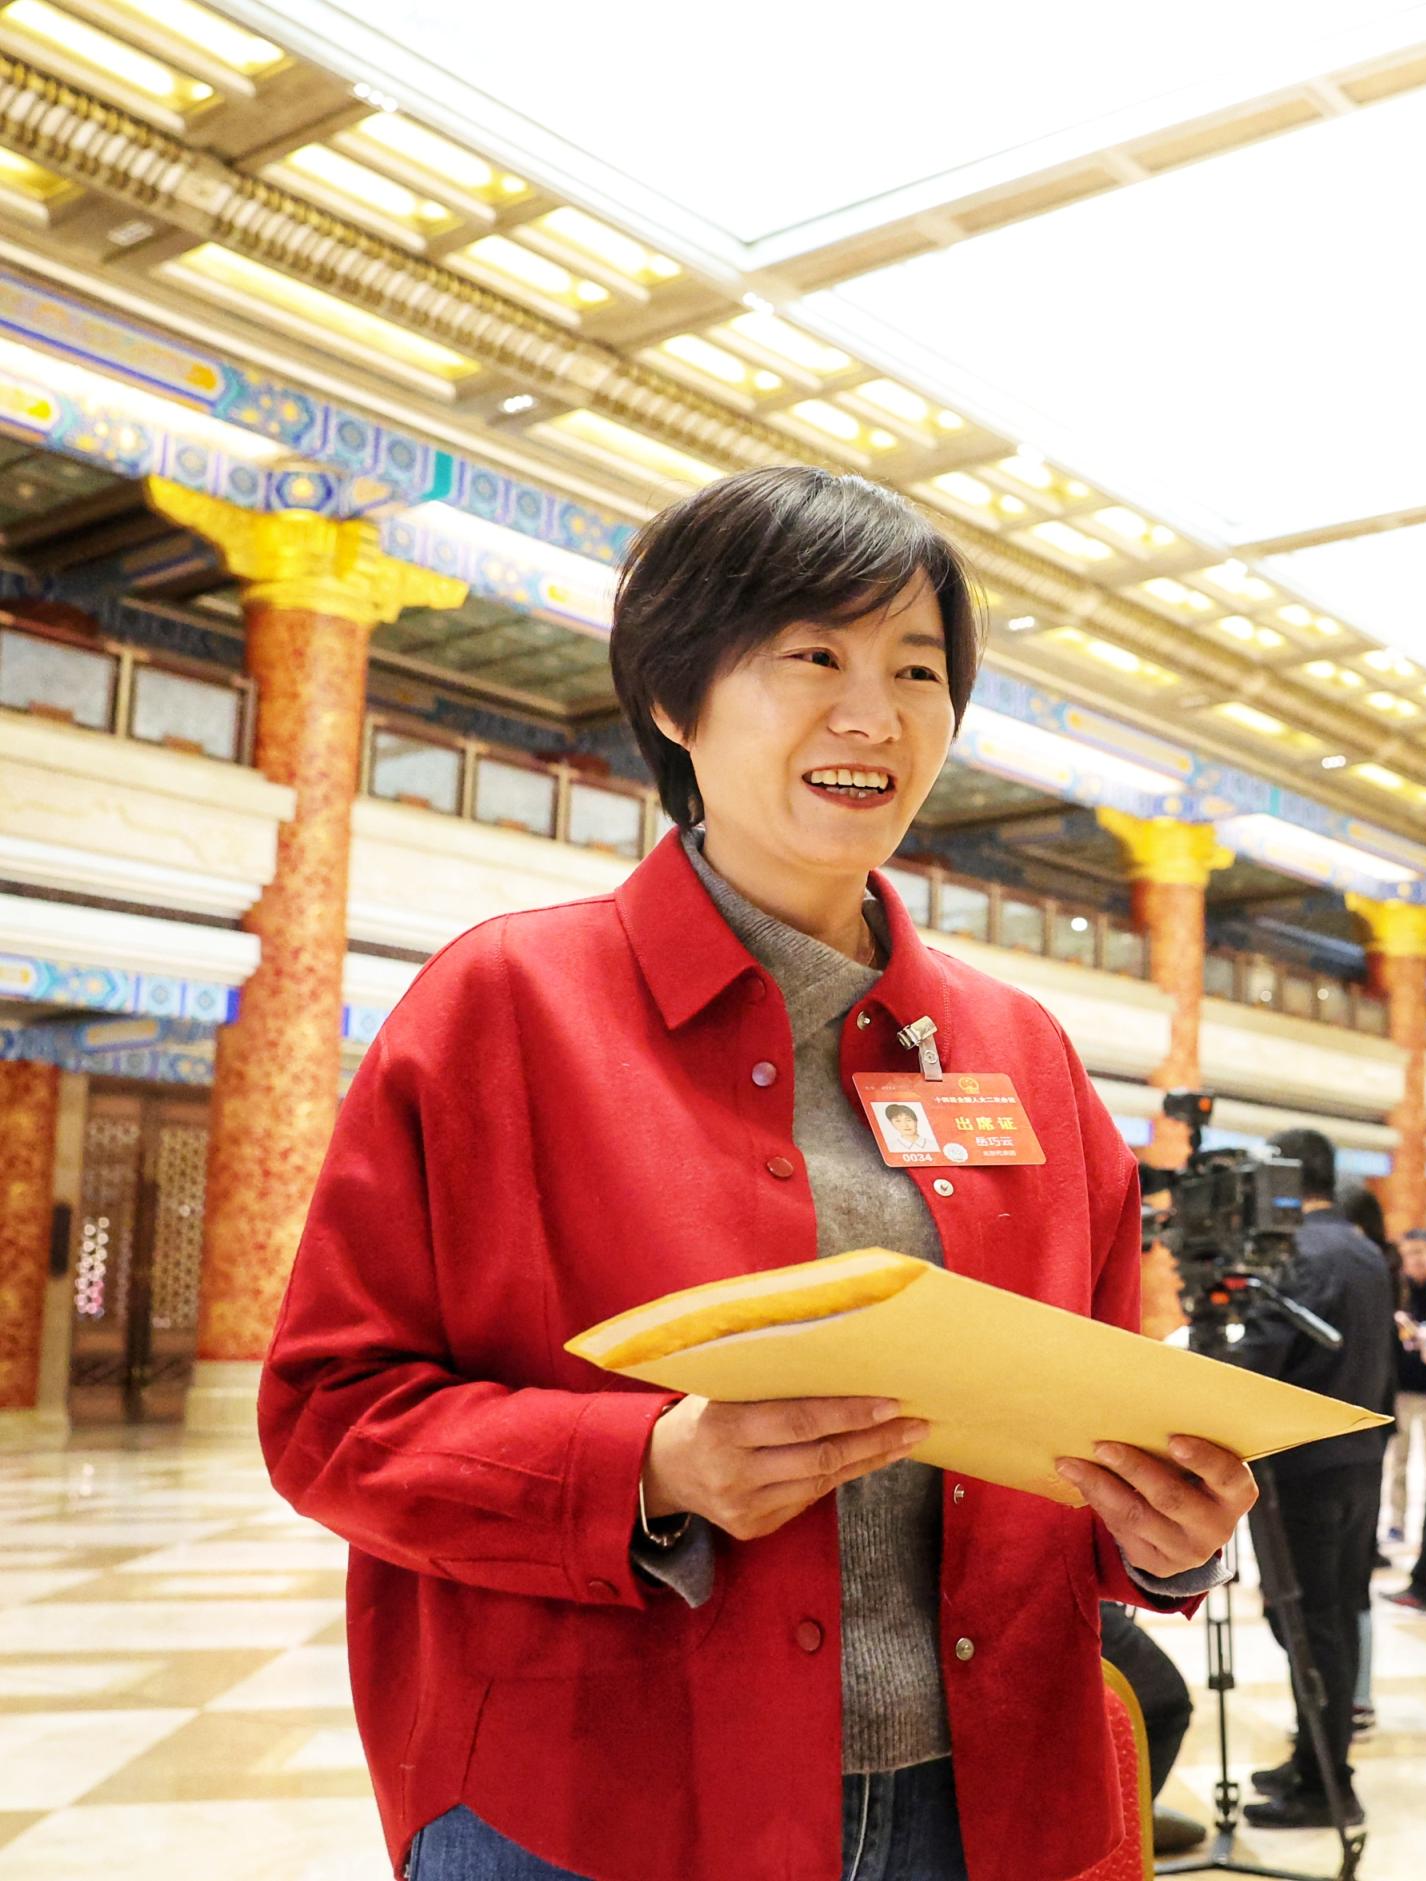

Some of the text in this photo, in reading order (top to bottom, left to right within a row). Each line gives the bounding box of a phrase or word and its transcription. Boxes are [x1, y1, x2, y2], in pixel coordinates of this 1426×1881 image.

[955, 1116, 1017, 1131] 出席证
[902, 1152, 933, 1162] 0034
